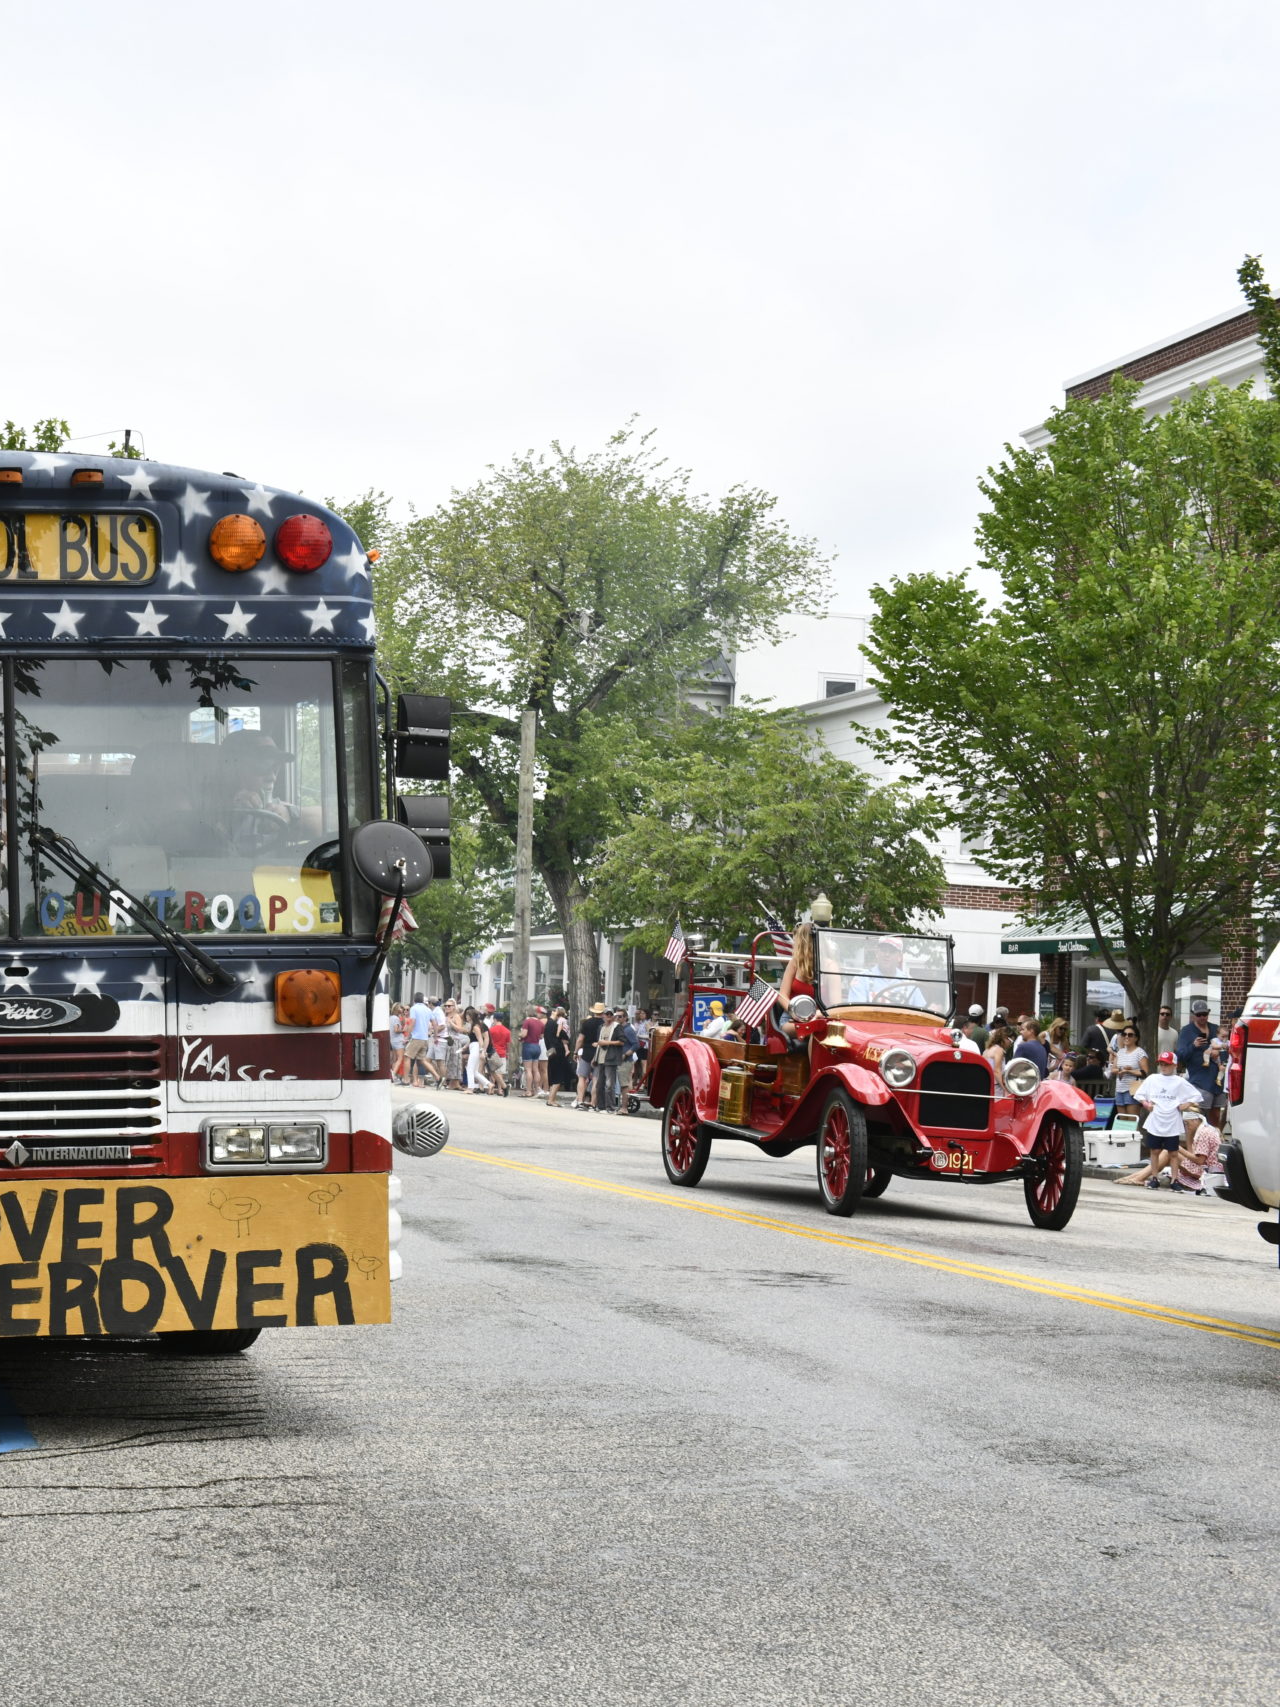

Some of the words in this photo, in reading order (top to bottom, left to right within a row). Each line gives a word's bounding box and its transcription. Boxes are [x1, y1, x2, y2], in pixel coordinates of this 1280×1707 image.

[60, 514, 148, 580] BUS
[41, 890, 135, 928] OUR
[150, 889, 315, 932] TROOPS
[32, 1146, 131, 1161] INTERNATIONAL
[949, 1152, 973, 1169] 1921
